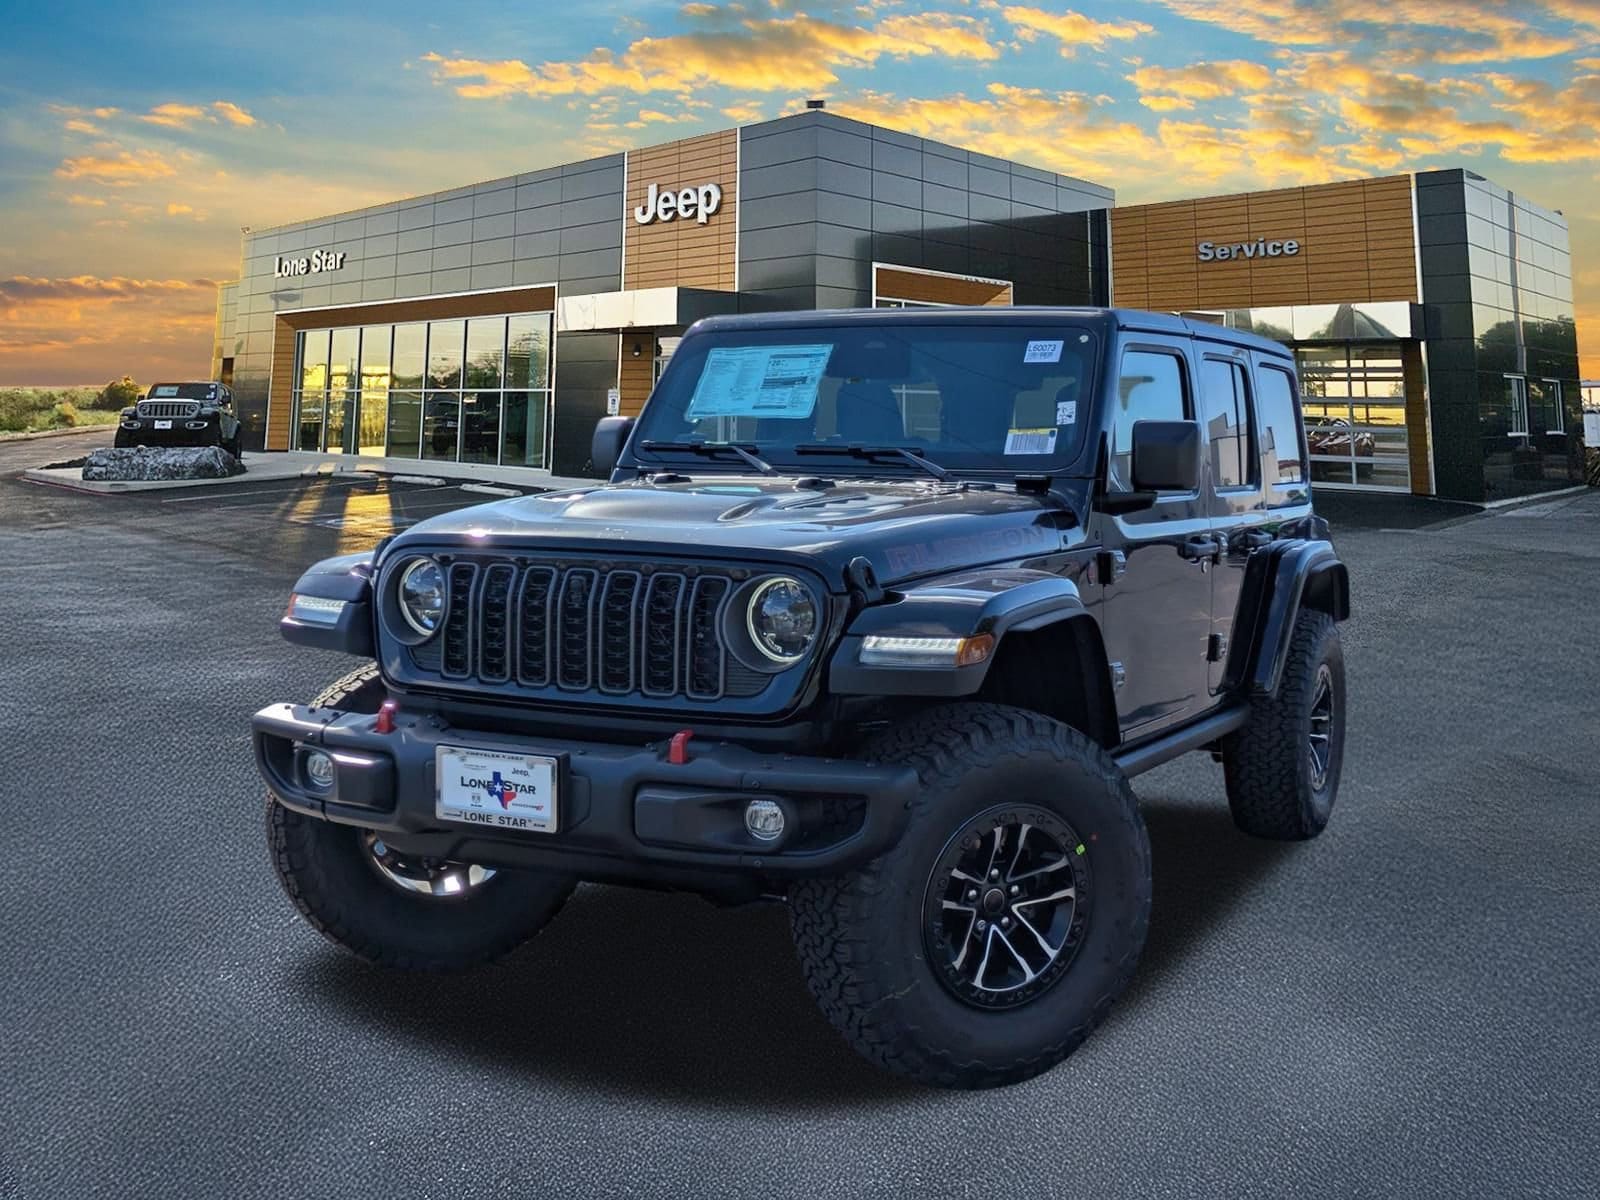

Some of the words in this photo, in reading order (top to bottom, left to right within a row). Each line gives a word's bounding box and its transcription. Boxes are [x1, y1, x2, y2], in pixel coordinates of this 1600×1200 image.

[634, 183, 722, 225] Jeep
[1198, 236, 1300, 261] Service
[274, 257, 309, 278] Lone
[311, 249, 345, 273] Star
[511, 767, 529, 777] Jeep
[460, 776, 494, 792] LONE
[503, 780, 536, 795] STAR
[464, 812, 493, 824] LONE
[498, 815, 528, 828] STAR
